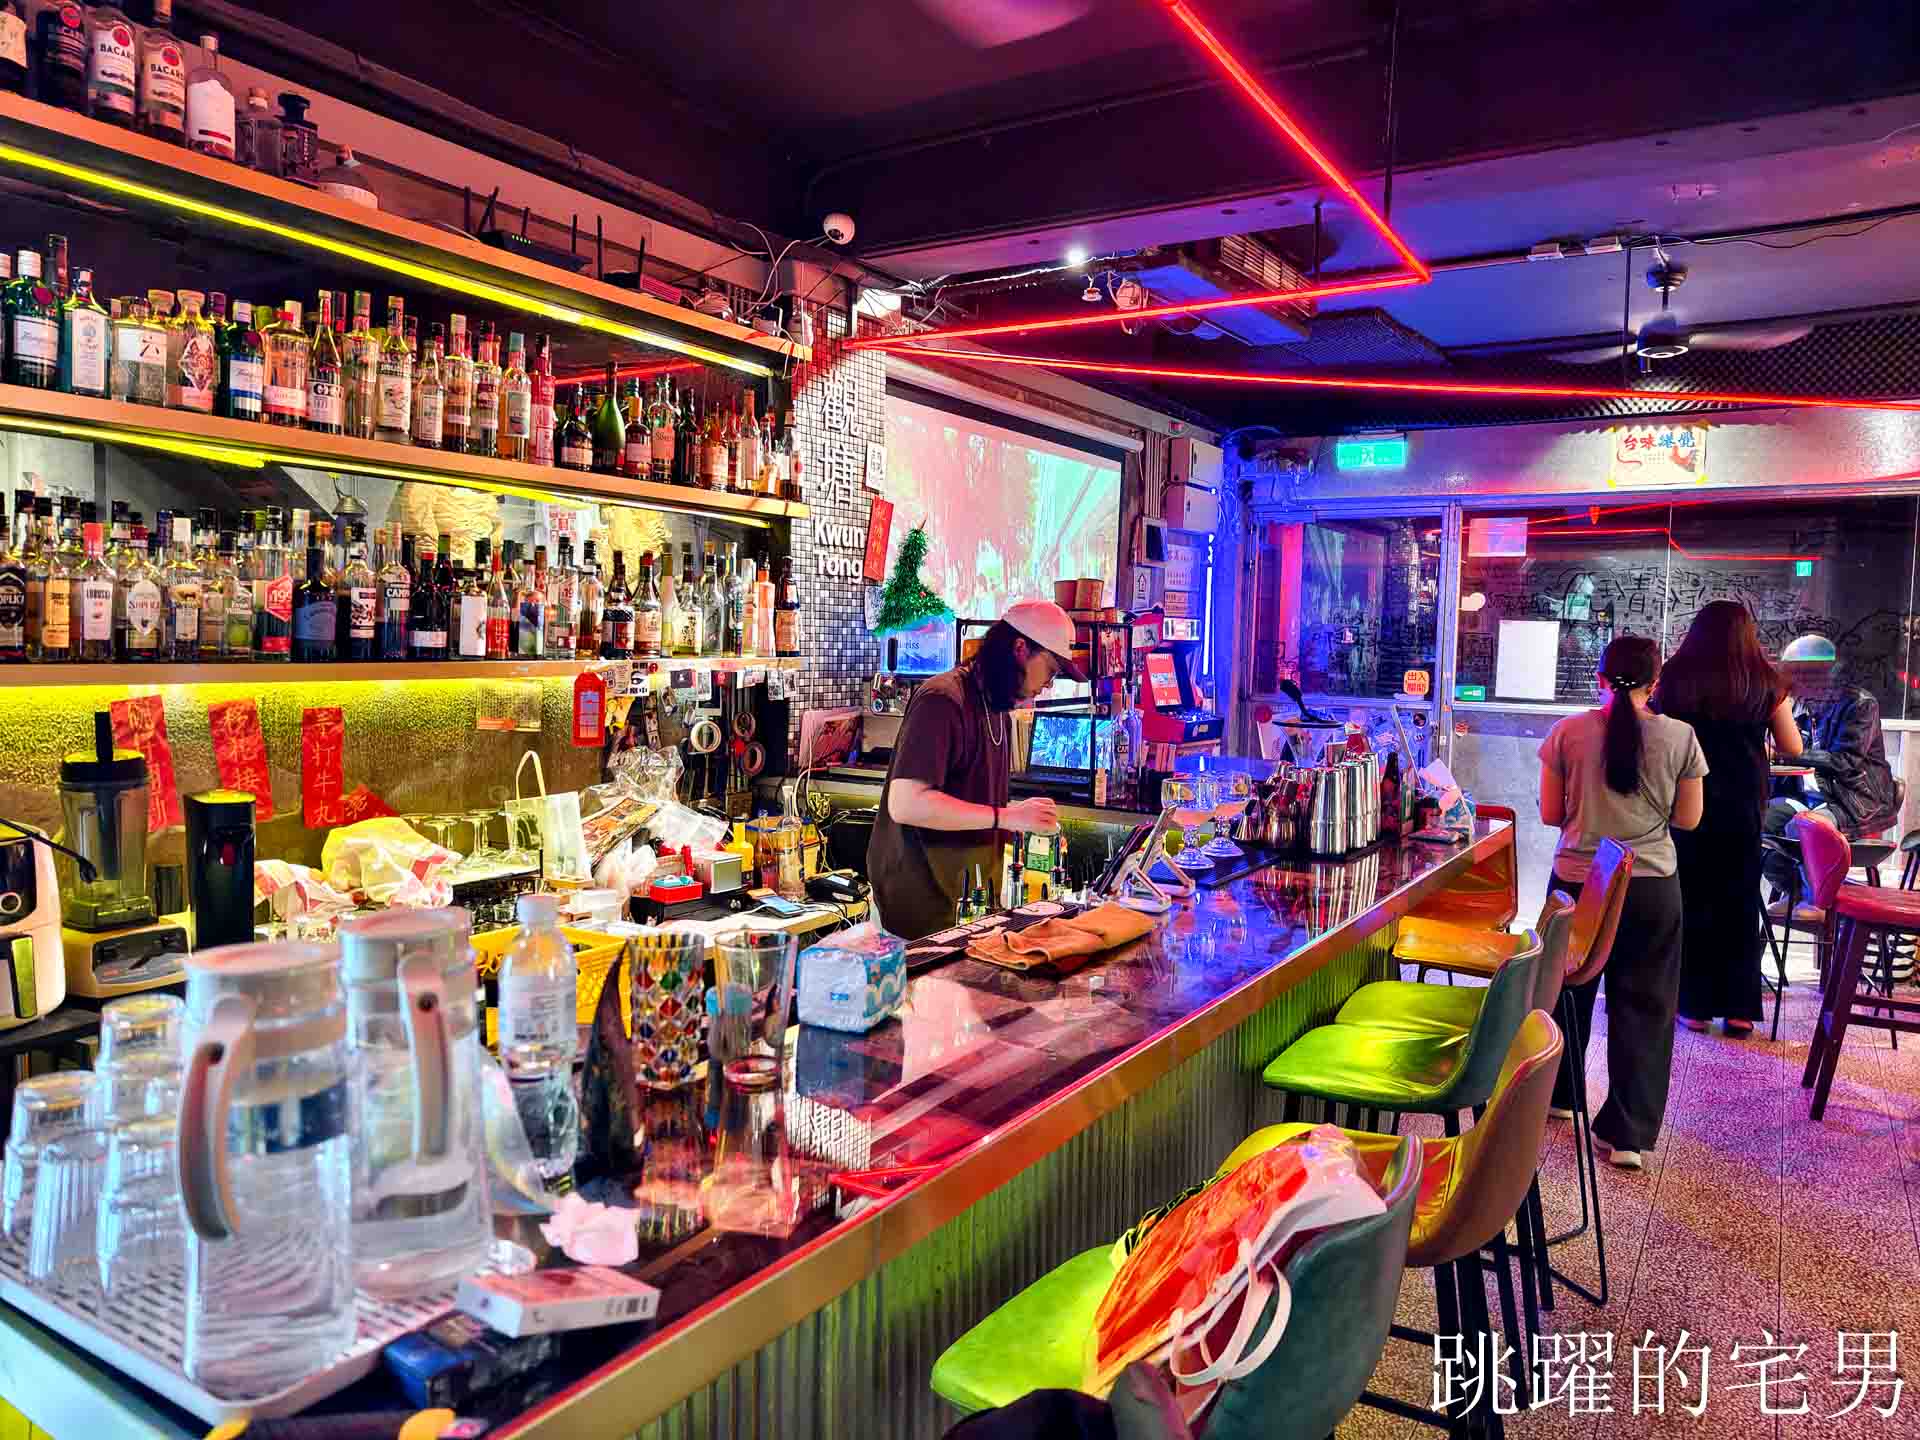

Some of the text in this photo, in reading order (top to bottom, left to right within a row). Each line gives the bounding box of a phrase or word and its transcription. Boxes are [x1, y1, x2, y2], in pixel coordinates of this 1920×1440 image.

[818, 371, 862, 508] 觀塘
[813, 516, 864, 549] Kwun
[815, 552, 863, 584] Tong
